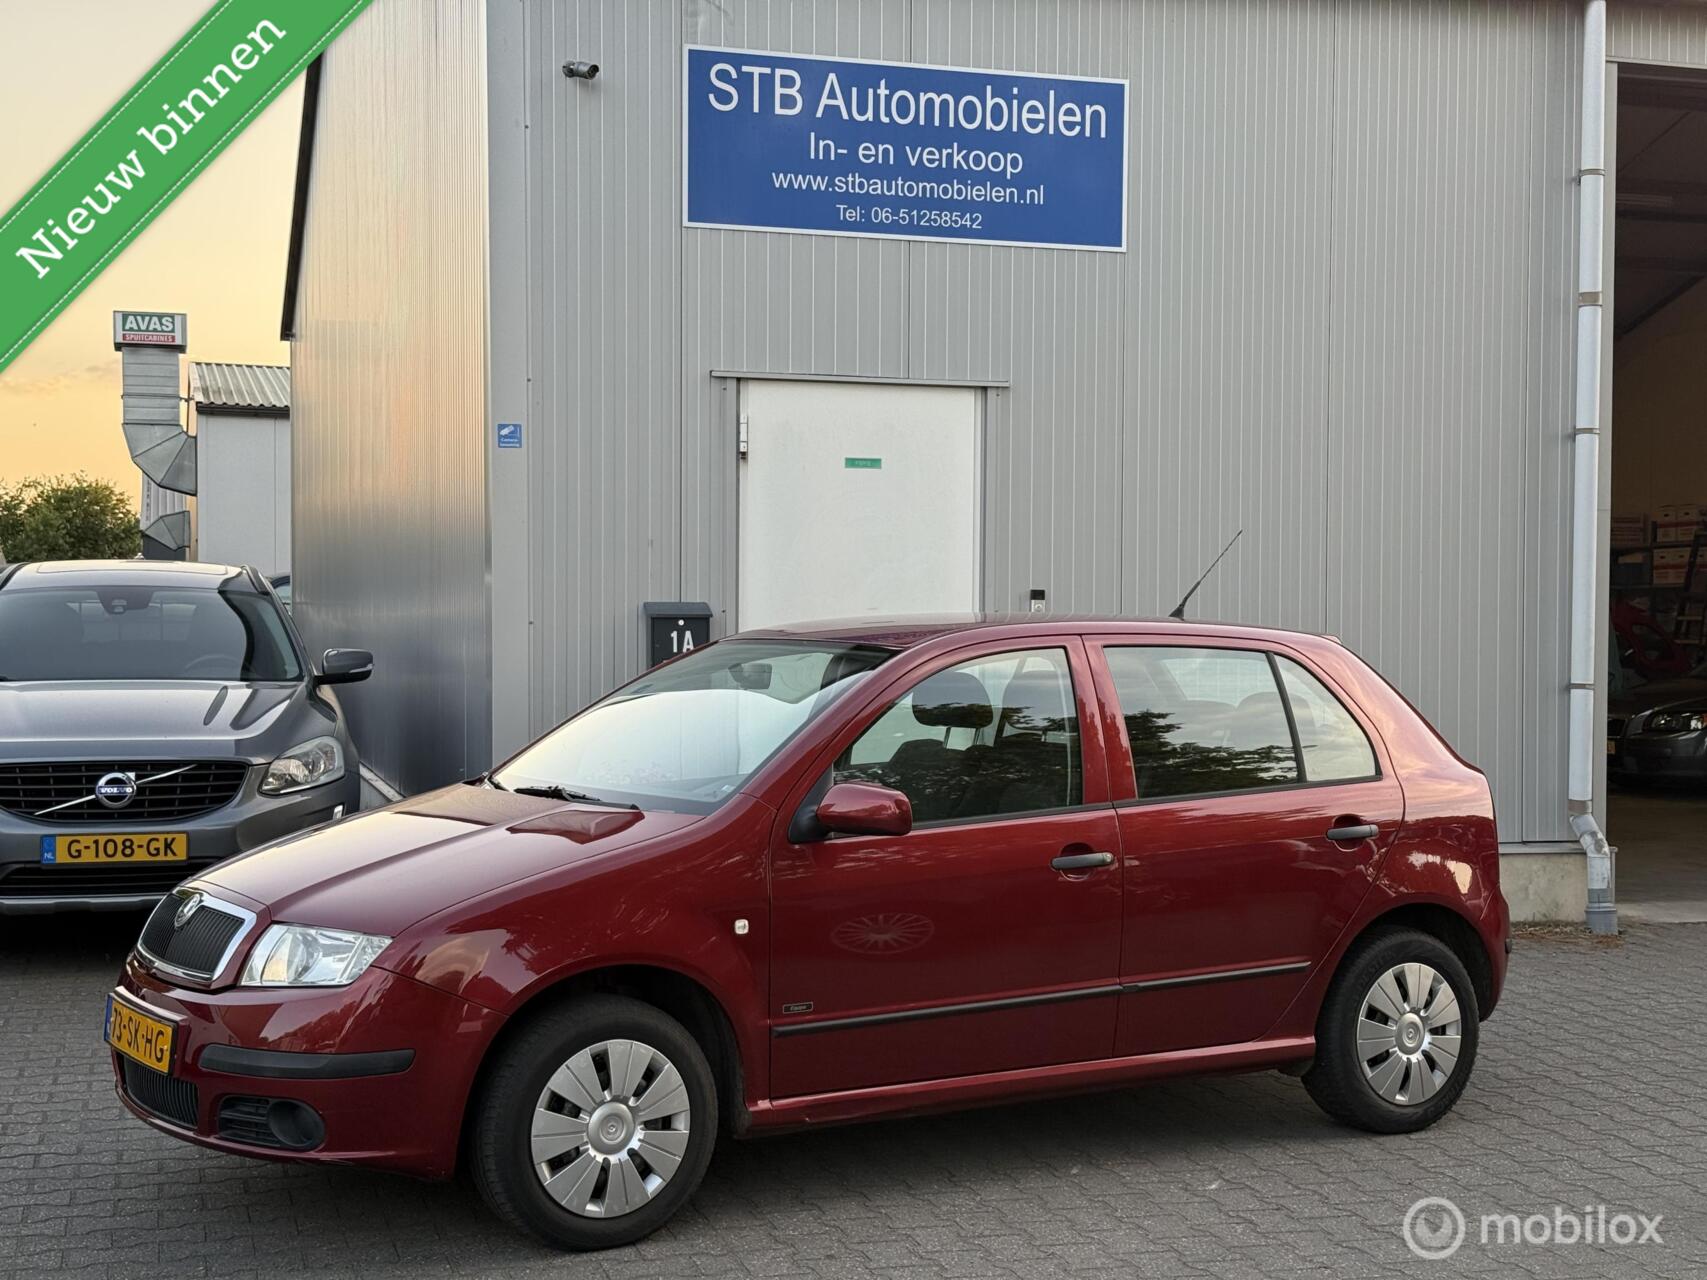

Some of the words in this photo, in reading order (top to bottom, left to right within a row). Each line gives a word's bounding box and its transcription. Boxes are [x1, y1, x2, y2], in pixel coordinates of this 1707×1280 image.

[708, 62, 803, 116] STB
[815, 72, 1107, 138] Automobielen
[809, 132, 848, 161] In-
[858, 143, 894, 165] en
[905, 143, 1023, 179] verkoop
[772, 170, 1044, 205] www.stbautomobielen.nl
[836, 204, 866, 223] Tel:
[871, 207, 983, 229] 06-51258542
[124, 315, 174, 332] AVAS
[125, 334, 173, 342] SPUITCABINES
[67, 837, 178, 859] G-108-GK
